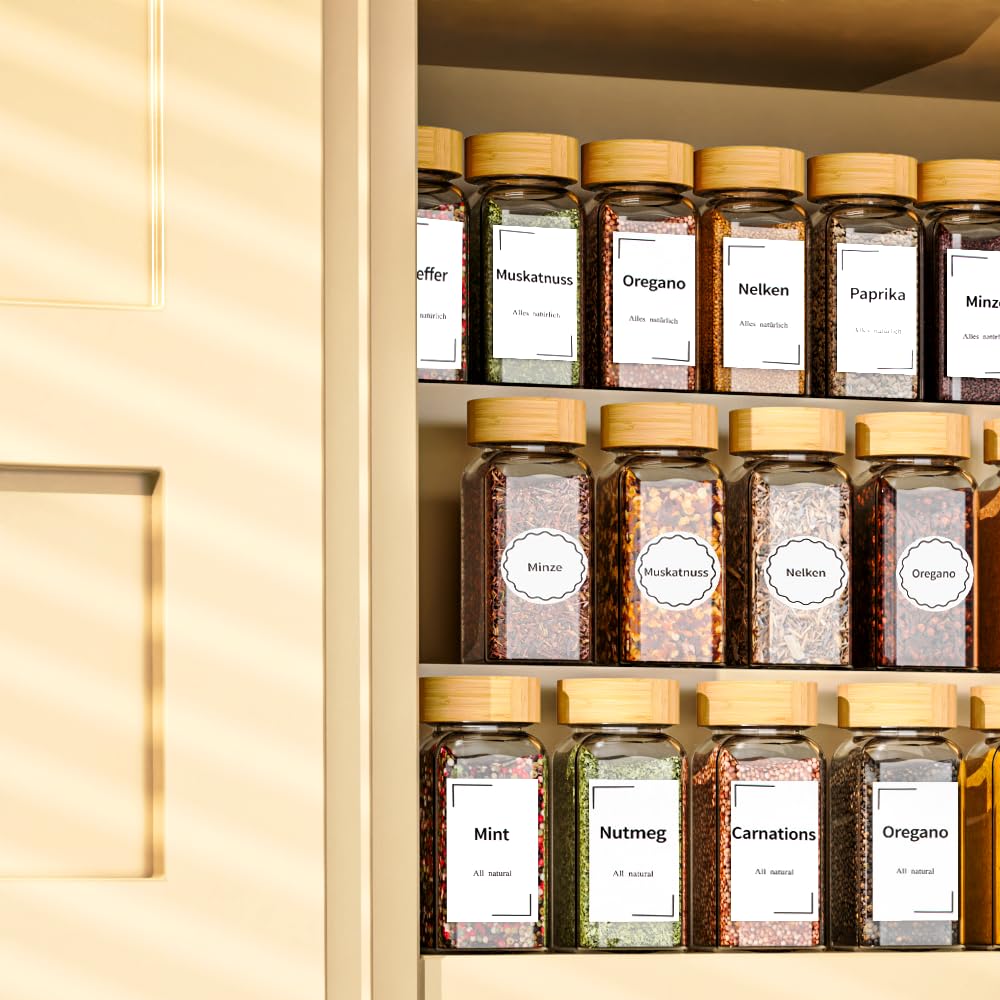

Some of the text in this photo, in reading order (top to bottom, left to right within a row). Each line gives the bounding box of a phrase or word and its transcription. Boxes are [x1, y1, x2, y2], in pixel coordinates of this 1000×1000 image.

[497, 269, 573, 286] Muskatnuss
[623, 275, 686, 292] Oregano
[739, 283, 789, 296] Nelken
[851, 288, 905, 303] Paprika
[628, 315, 646, 323] Alles
[528, 562, 562, 572] Minze
[644, 567, 708, 577] Muskatnuss
[786, 568, 826, 577] Nelken
[912, 569, 955, 581] Oregano
[475, 827, 509, 841] Mint
[600, 826, 667, 843] Nutmeg
[732, 827, 816, 841] Carnations
[883, 826, 948, 841] Oregano
[472, 869, 512, 877] All natural
[612, 869, 654, 878] All natural
[769, 868, 794, 876] natural
[896, 867, 935, 875] All natural
